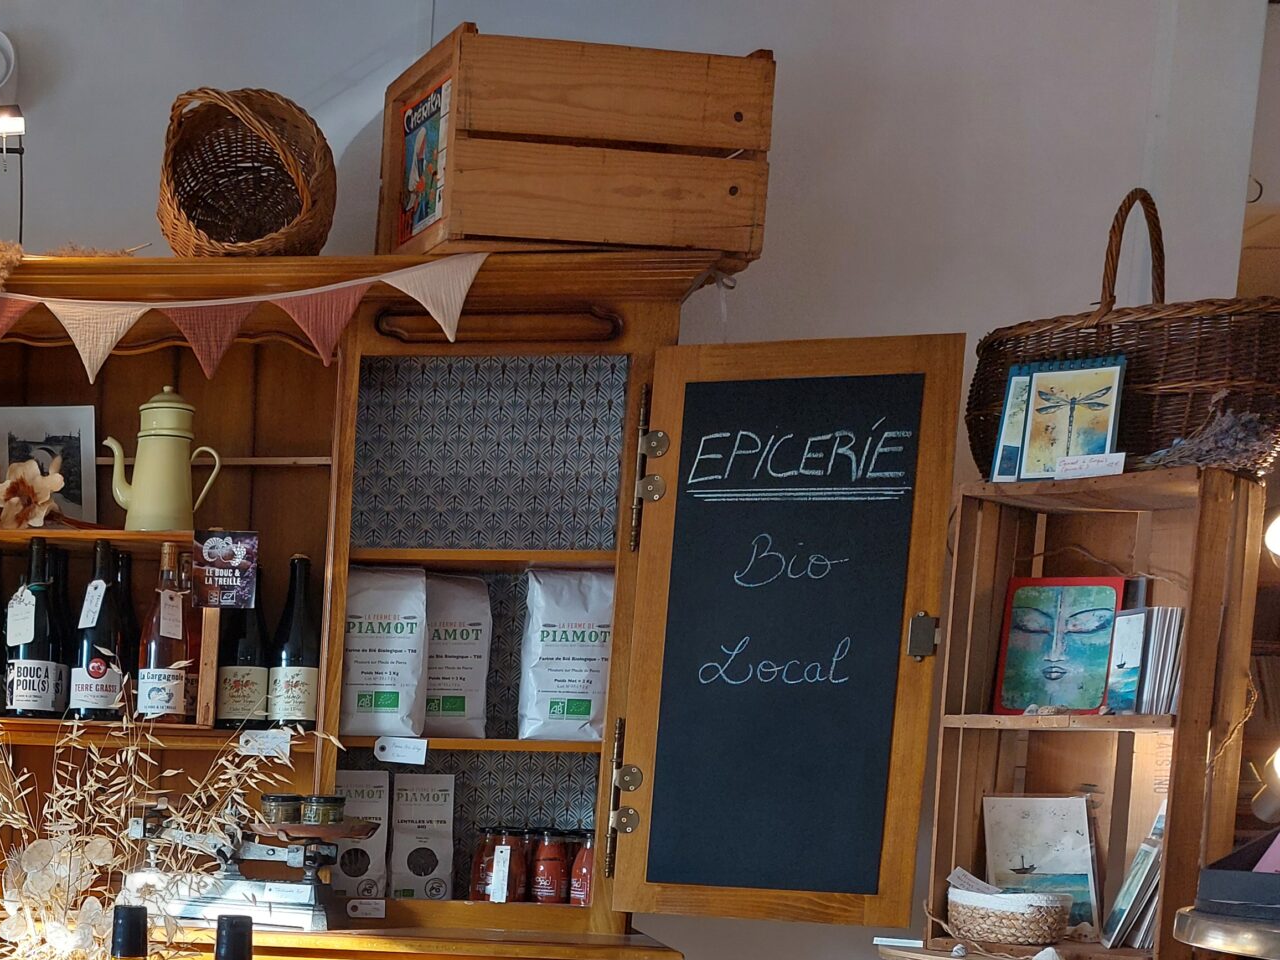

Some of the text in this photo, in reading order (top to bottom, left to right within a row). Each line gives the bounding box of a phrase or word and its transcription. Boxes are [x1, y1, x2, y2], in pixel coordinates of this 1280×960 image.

[733, 533, 850, 587] Bio
[205, 568, 241, 577] LE BOUC &
[204, 577, 242, 586] LA TREILLE
[345, 621, 418, 634] PIAMOT
[432, 628, 483, 641] AMOT
[540, 630, 611, 643] PIAMOT
[698, 636, 851, 684] Local
[16, 666, 42, 679] BOUC
[147, 671, 184, 682] Gargagnole
[15, 679, 50, 694] POIL(S)
[74, 683, 93, 692] TERRE
[95, 683, 117, 693] GRASSE
[396, 792, 450, 803] PIAMOT
